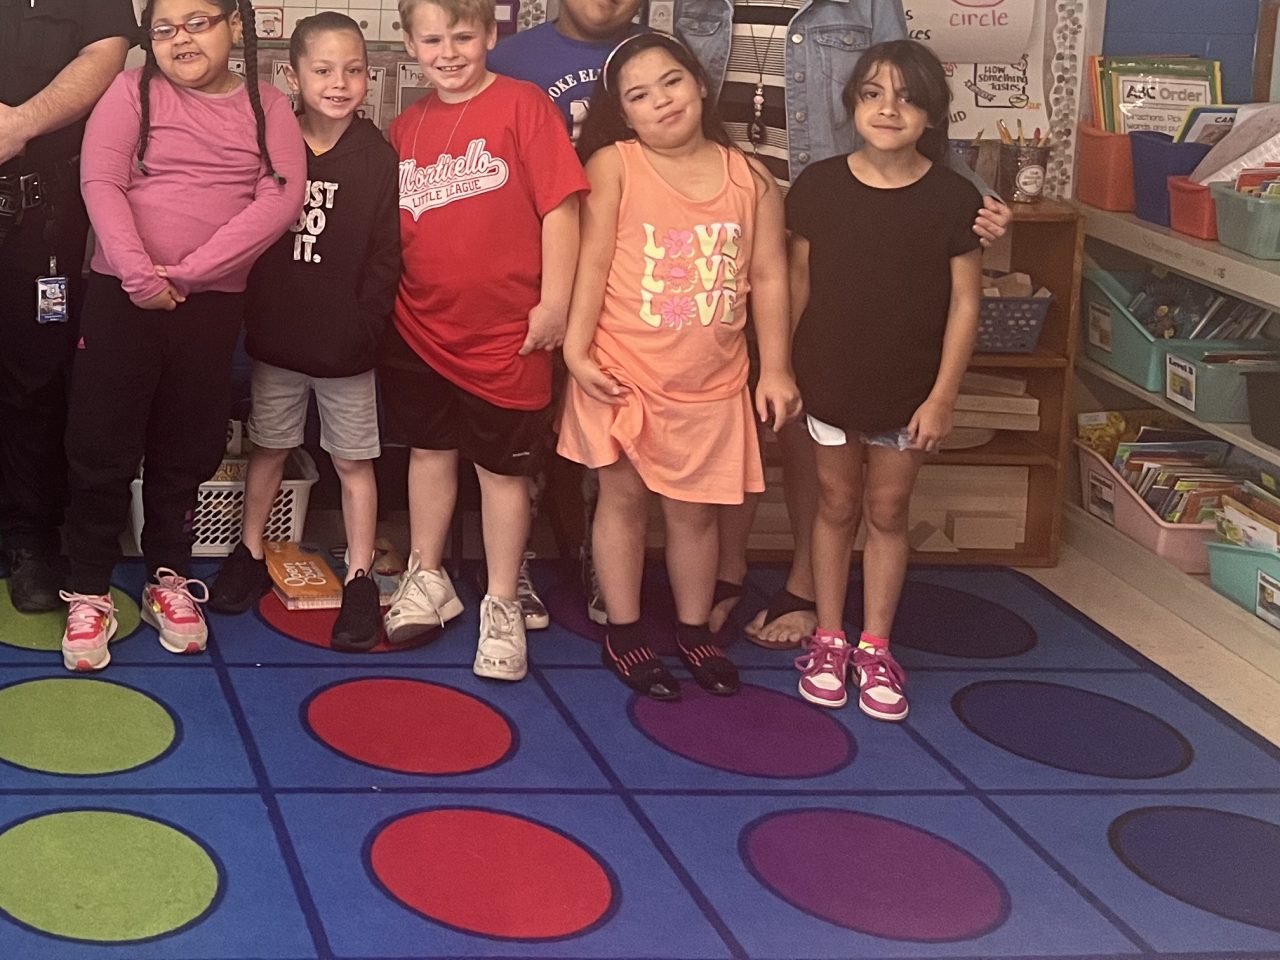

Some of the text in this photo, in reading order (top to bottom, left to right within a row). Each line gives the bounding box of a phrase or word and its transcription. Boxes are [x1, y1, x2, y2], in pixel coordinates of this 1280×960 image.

[949, 9, 1009, 28] circle
[1126, 85, 1203, 103] ABC Order
[399, 138, 493, 195] Monticello
[412, 179, 481, 208] LITTLE LEAGUE
[293, 233, 322, 264] IT.
